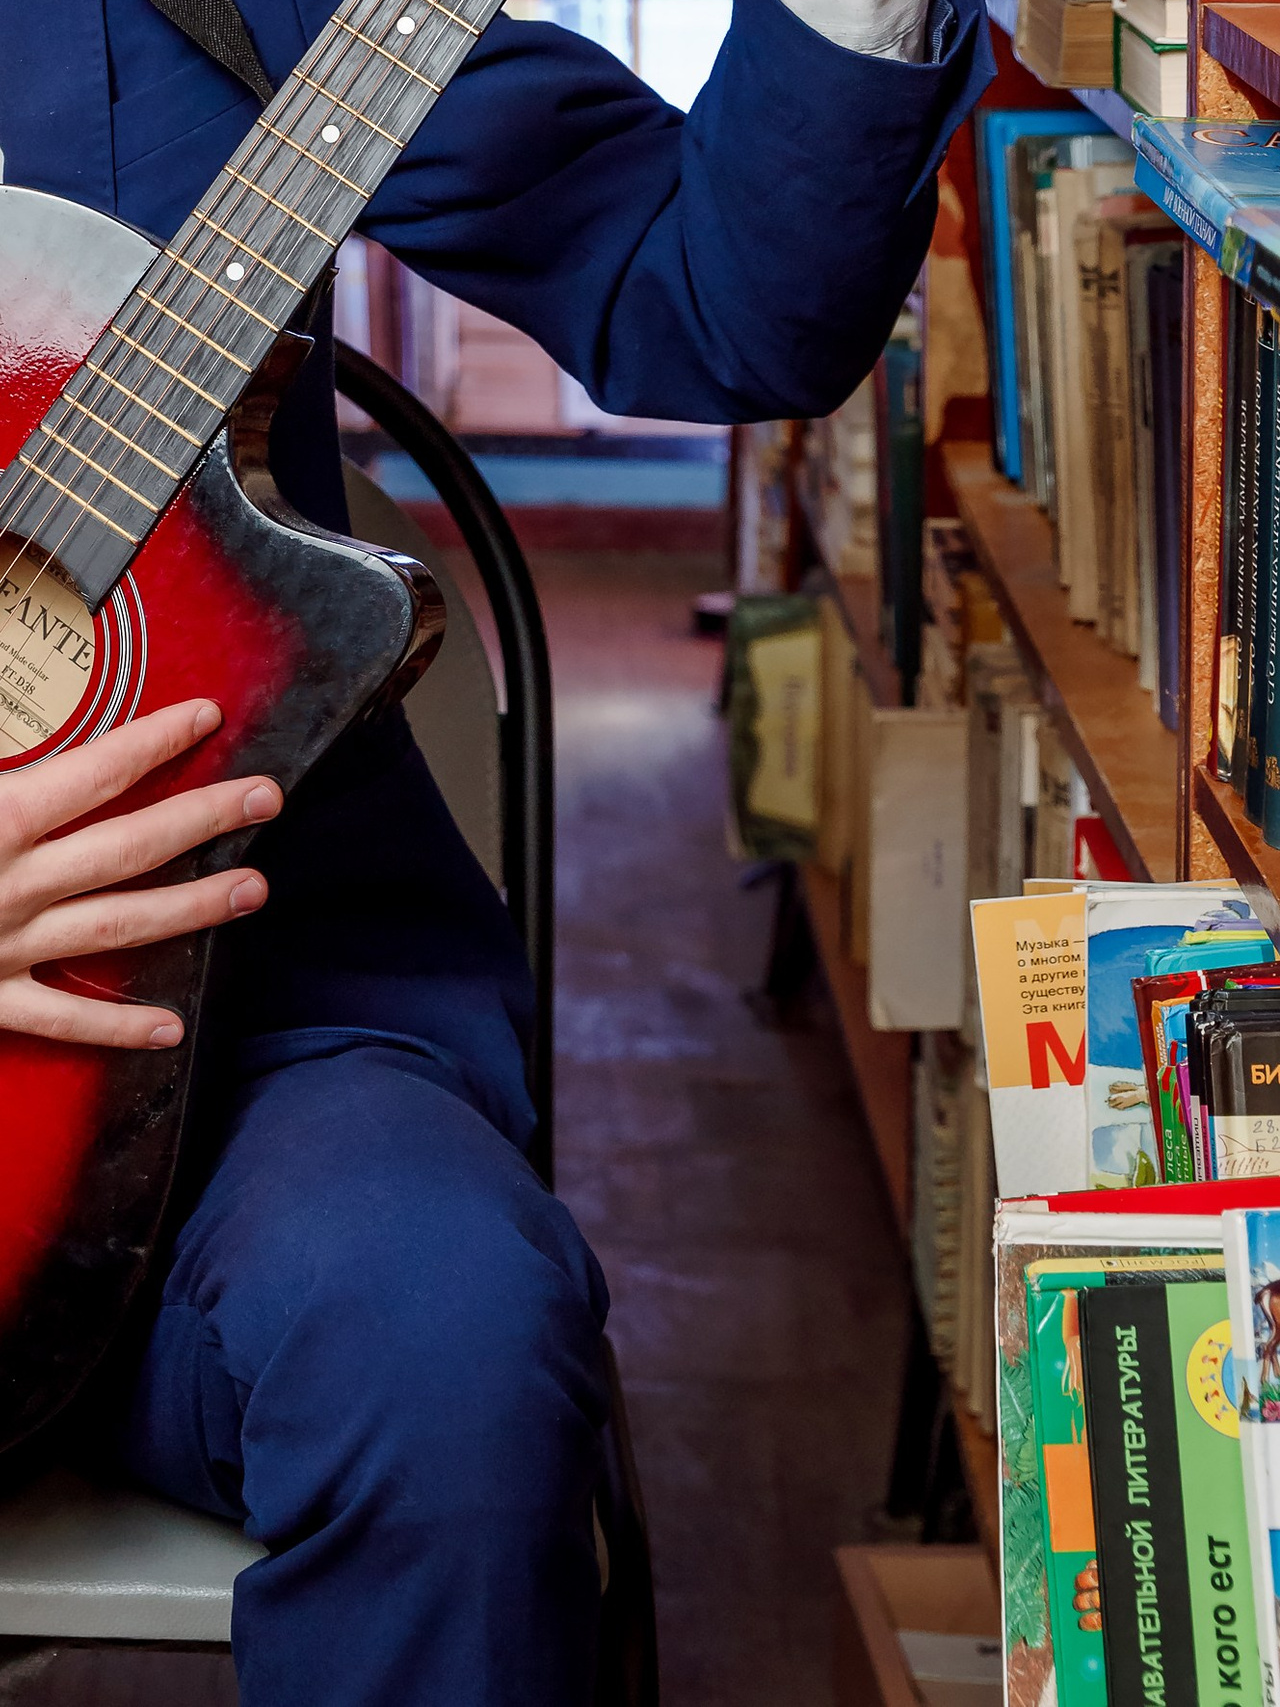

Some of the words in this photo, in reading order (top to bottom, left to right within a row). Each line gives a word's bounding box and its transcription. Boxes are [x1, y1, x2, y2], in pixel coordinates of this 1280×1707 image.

[0, 664, 37, 696] FT-D38
[9, 647, 30, 667] Made
[27, 661, 50, 683] Guitar
[1267, 660, 1277, 705] СТО
[1016, 938, 1070, 954] Музыка
[1017, 958, 1026, 968] о
[1019, 974, 1028, 984] а
[1031, 969, 1079, 984] другие
[1020, 984, 1086, 1001] существу
[1022, 1003, 1049, 1015] Эта
[1026, 1020, 1086, 1090] М
[1164, 1128, 1174, 1175] леса
[1193, 1117, 1203, 1182] ПИЩЕВЫ
[1114, 1323, 1151, 1508] ЛИТЕРАТУРЫ
[1206, 1533, 1235, 1593] ест
[1124, 1519, 1167, 1707] АВАТЕЛЬНОЙ
[1213, 1603, 1243, 1691] кого
